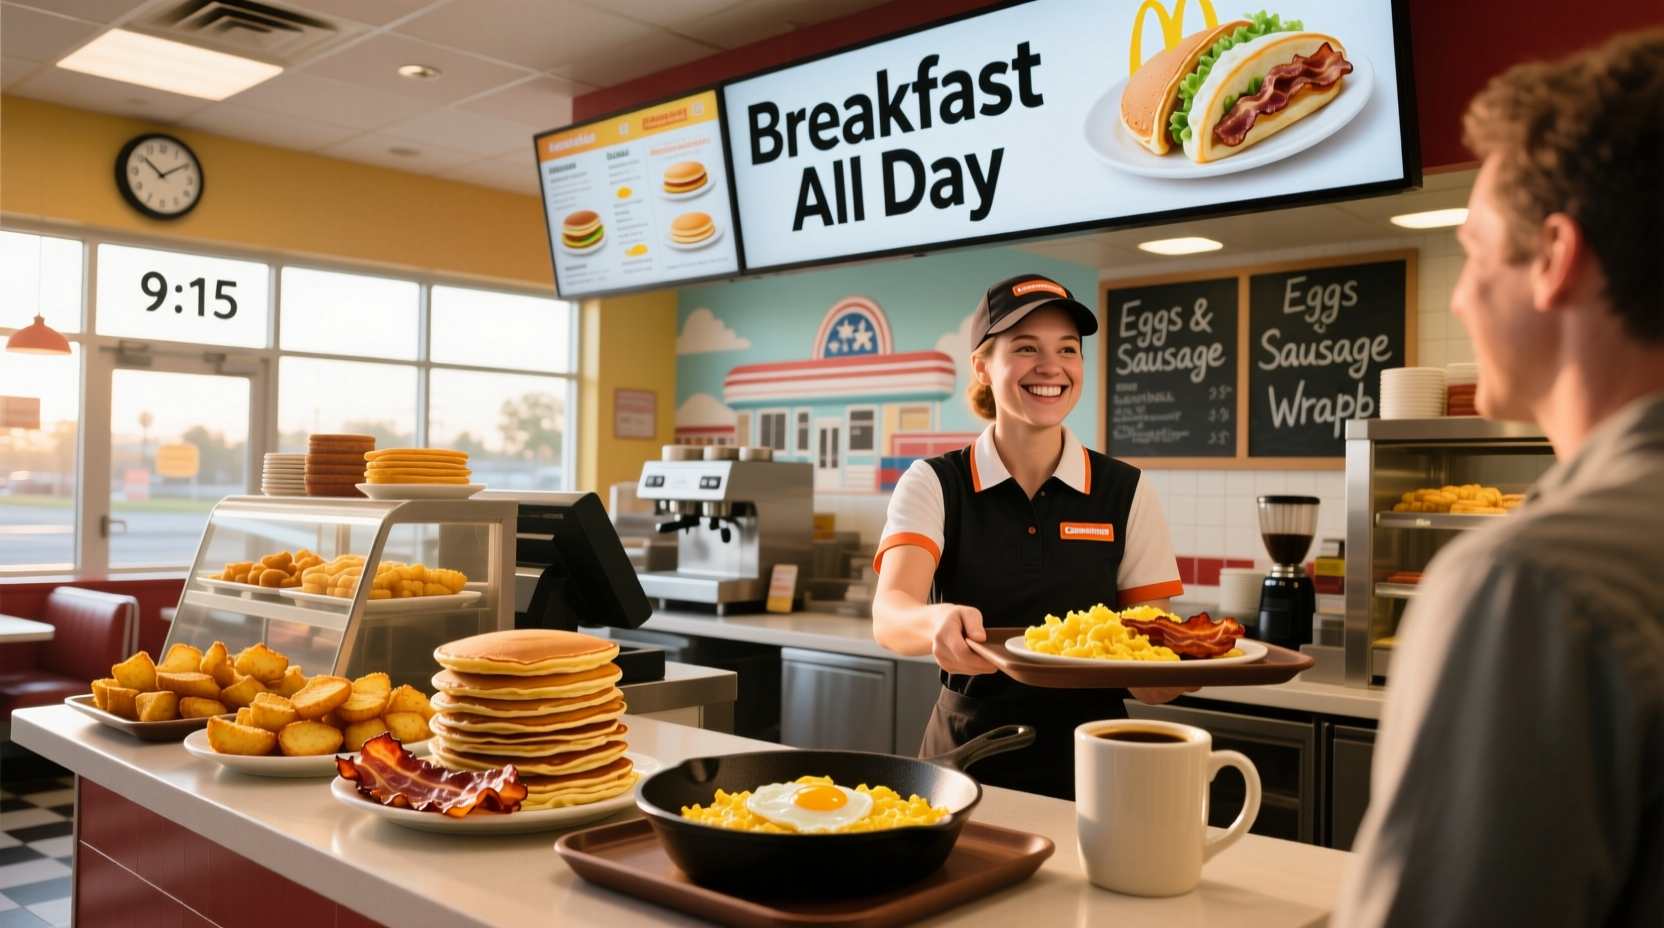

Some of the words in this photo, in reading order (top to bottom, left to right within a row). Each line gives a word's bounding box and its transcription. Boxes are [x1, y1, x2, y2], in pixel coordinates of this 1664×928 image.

[747, 40, 1044, 166] Breakfast
[792, 155, 865, 232] All
[881, 147, 1005, 222] Day
[140, 271, 238, 320] 9:15
[1282, 275, 1359, 325] Eggs
[1119, 298, 1184, 348] Eggs
[1189, 297, 1214, 334] &
[1115, 342, 1227, 384] Sausage
[1257, 328, 1393, 380] Sausage
